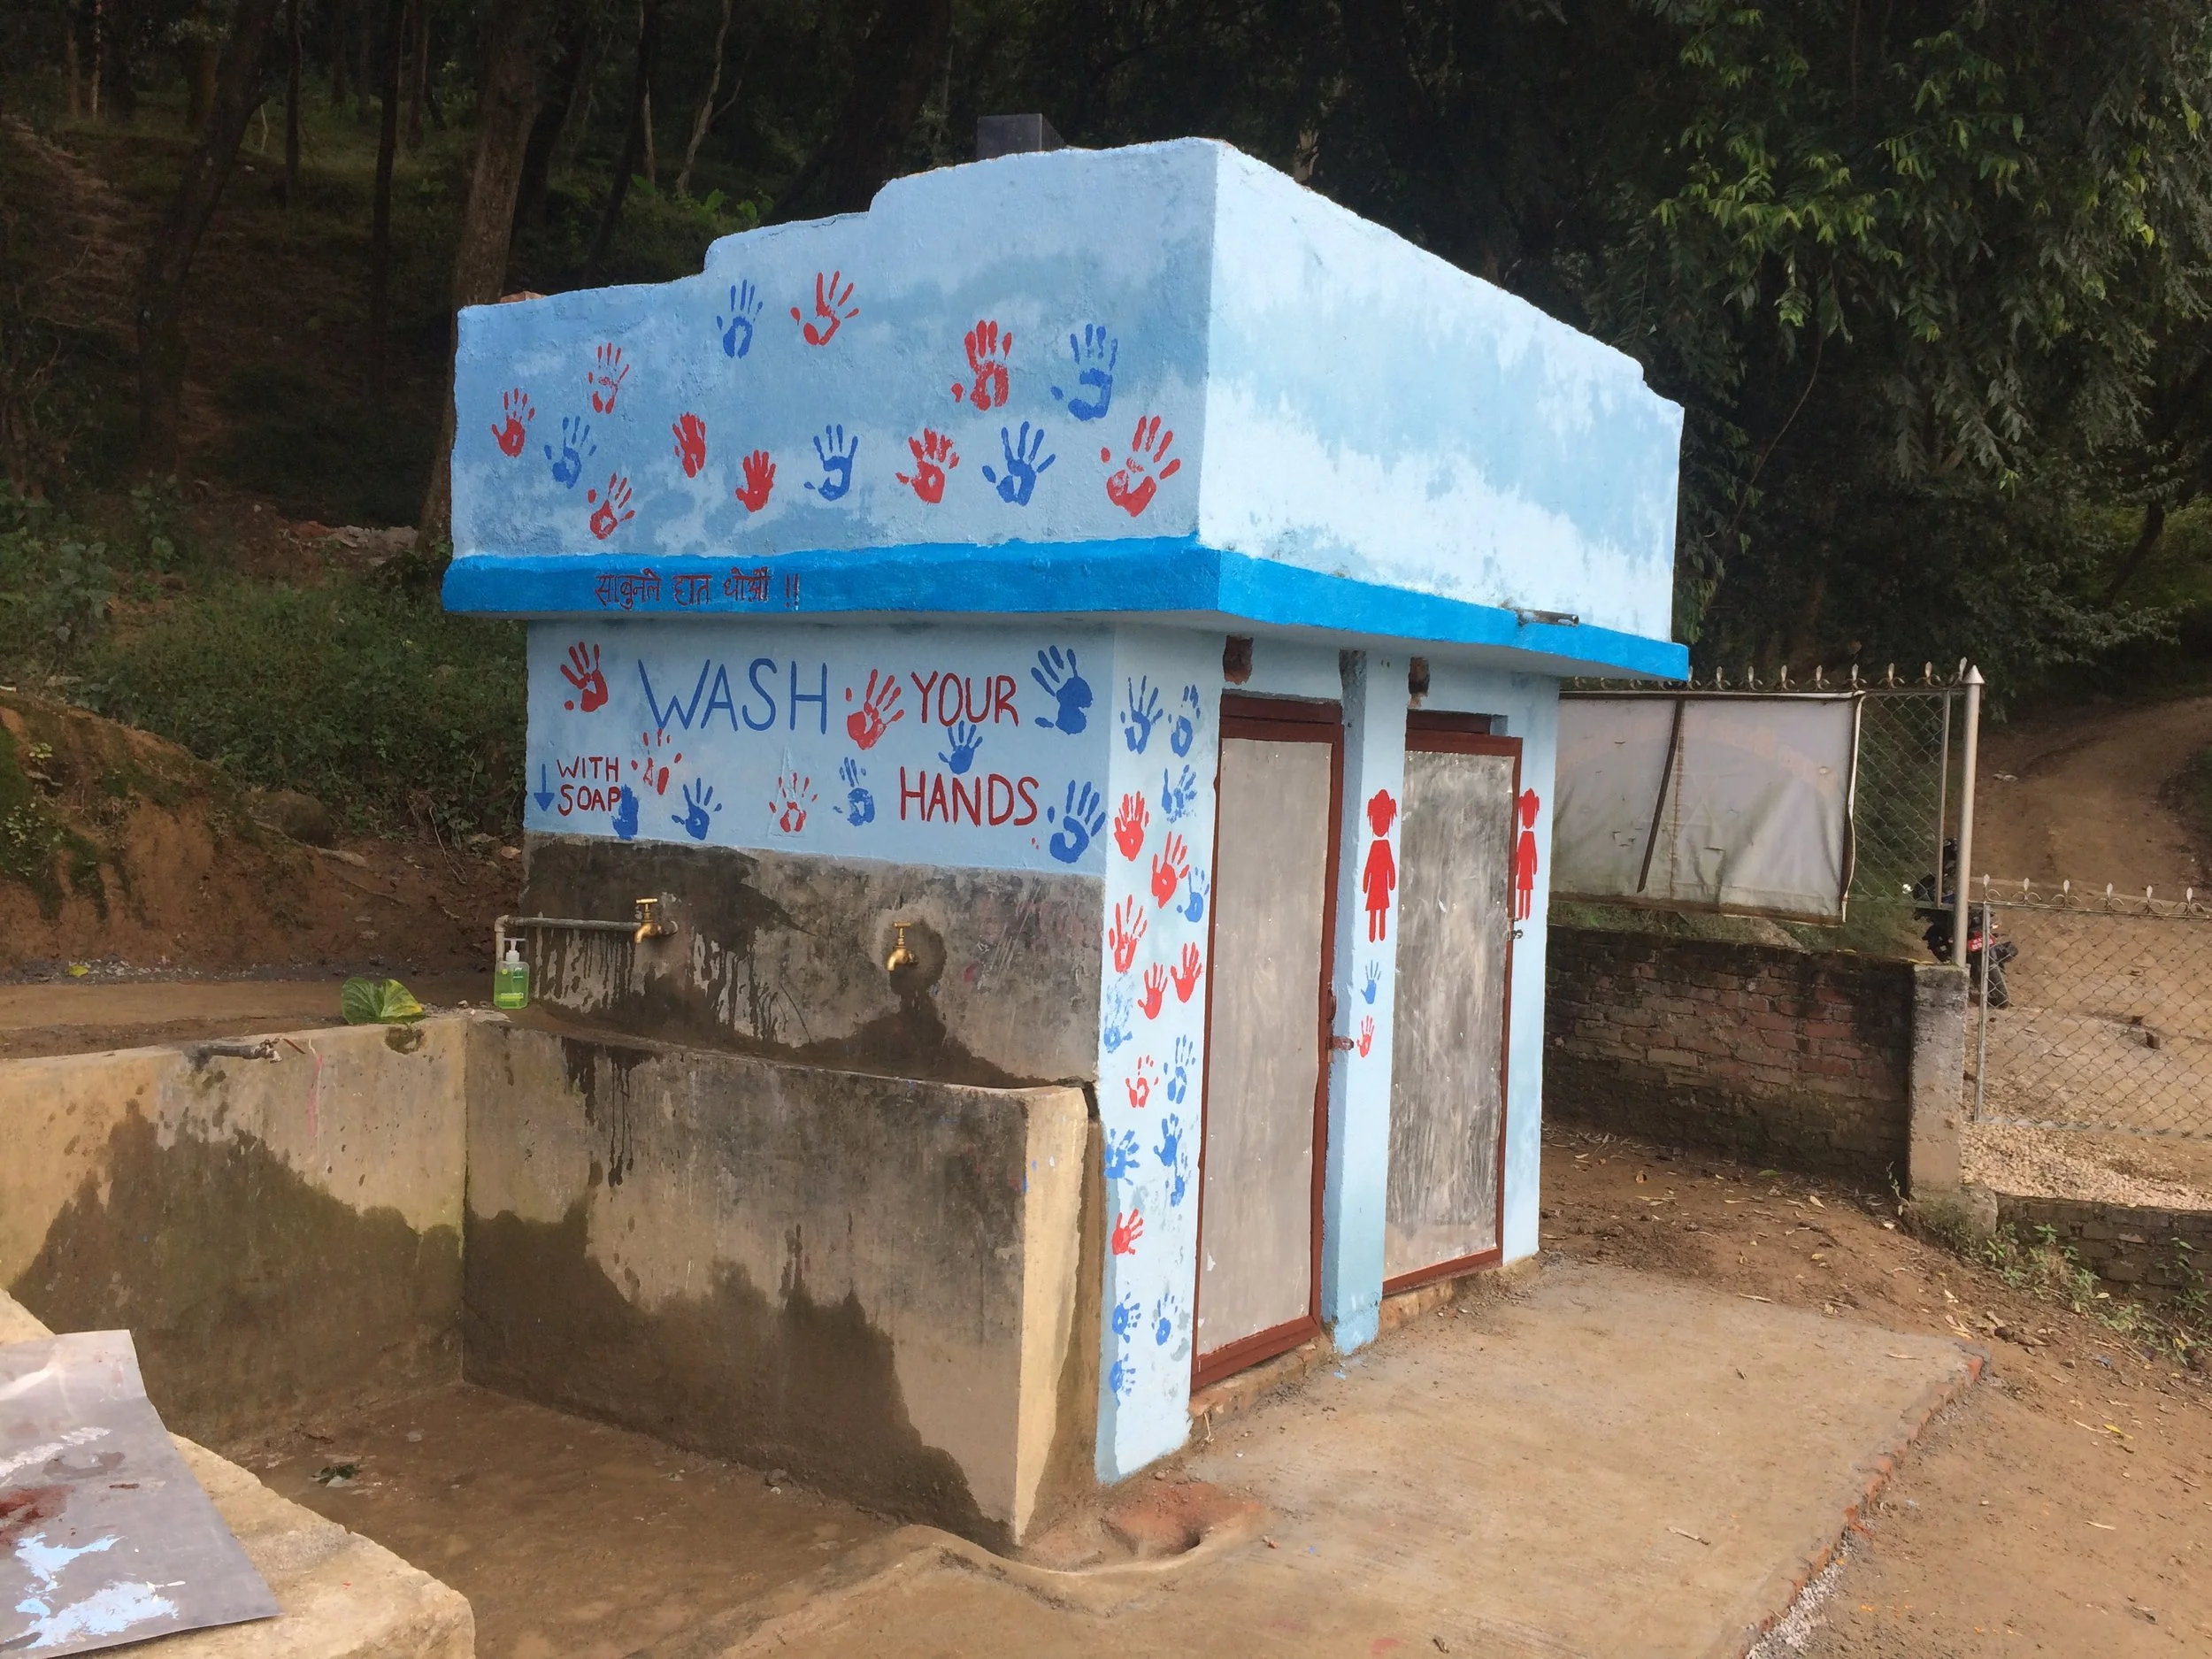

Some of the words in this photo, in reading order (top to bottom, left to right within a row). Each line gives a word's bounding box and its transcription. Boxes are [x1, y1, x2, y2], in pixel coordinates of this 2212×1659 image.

[672, 573, 712, 606] हात
[637, 657, 828, 734] WASH
[910, 670, 1020, 727] YOUR
[556, 755, 620, 783] WITH
[557, 783, 622, 817] SOAP
[899, 765, 1040, 827] HANDS
